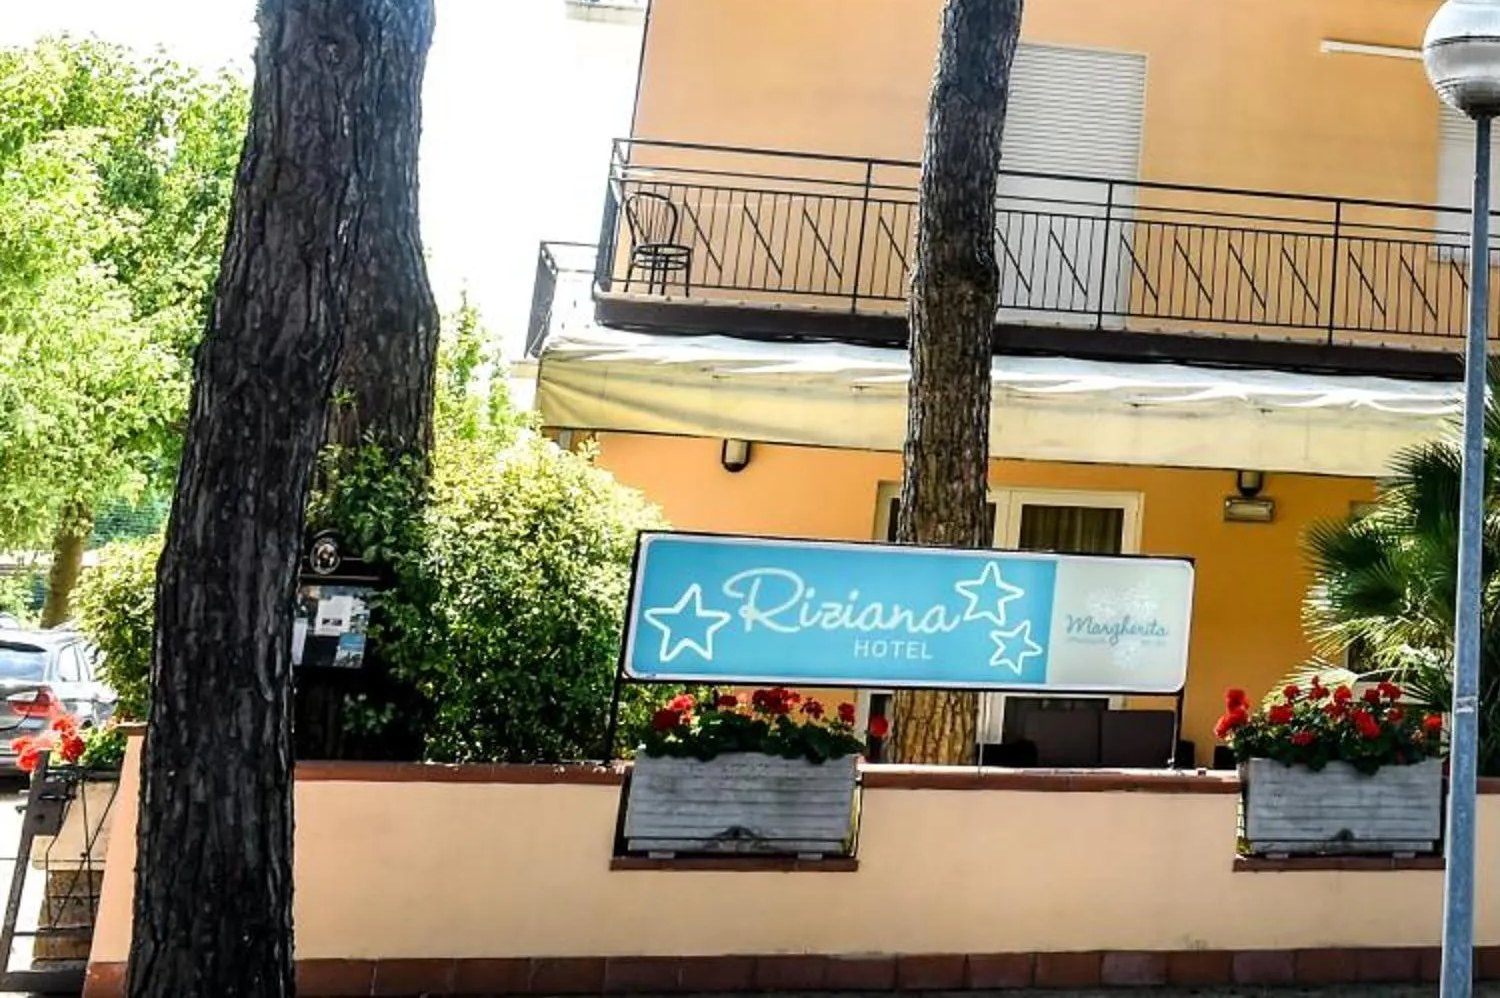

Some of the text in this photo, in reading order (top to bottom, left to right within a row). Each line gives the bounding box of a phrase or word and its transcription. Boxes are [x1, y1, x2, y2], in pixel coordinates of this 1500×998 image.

[723, 567, 960, 633] Riziana
[1065, 613, 1168, 647] Margherita
[853, 638, 933, 660] HOTEL
